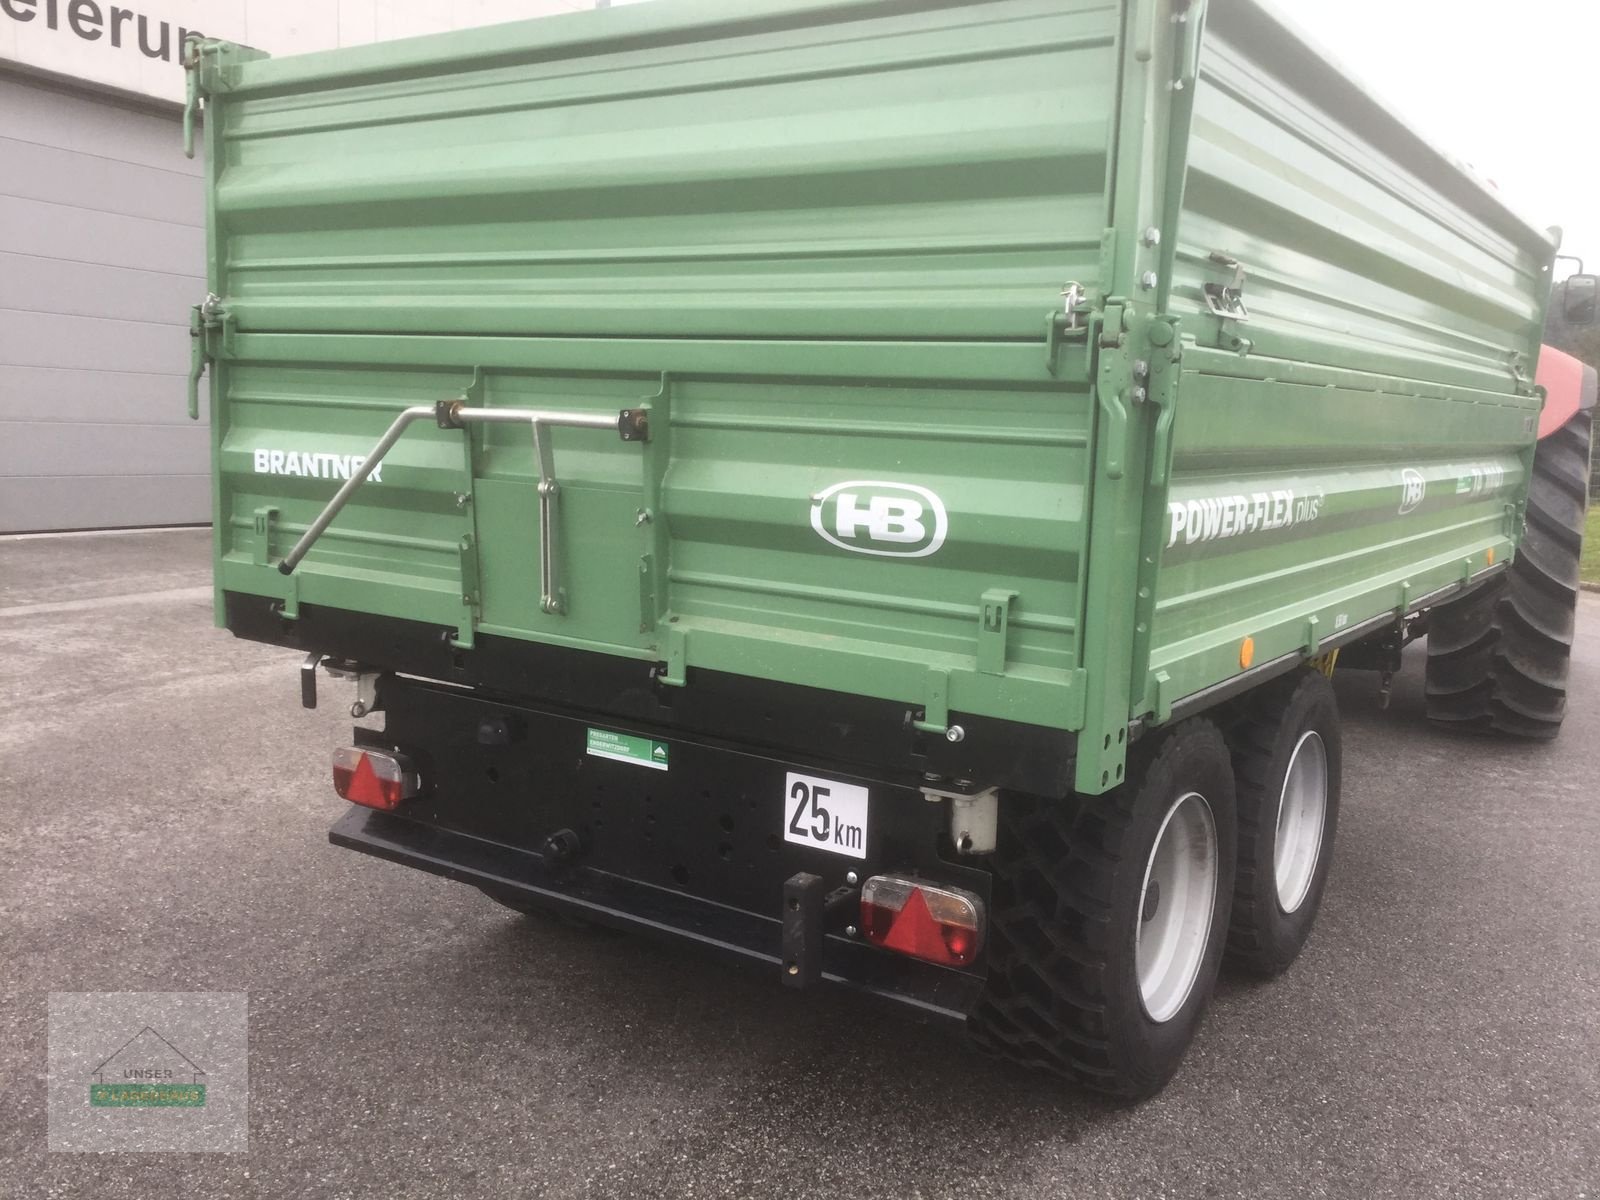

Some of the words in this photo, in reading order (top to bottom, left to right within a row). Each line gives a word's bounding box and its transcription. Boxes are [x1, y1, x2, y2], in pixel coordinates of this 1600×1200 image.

[836, 493, 925, 543] HB
[1167, 489, 1294, 548] POWER-FLEX
[789, 781, 830, 842] 25
[834, 816, 862, 849] km
